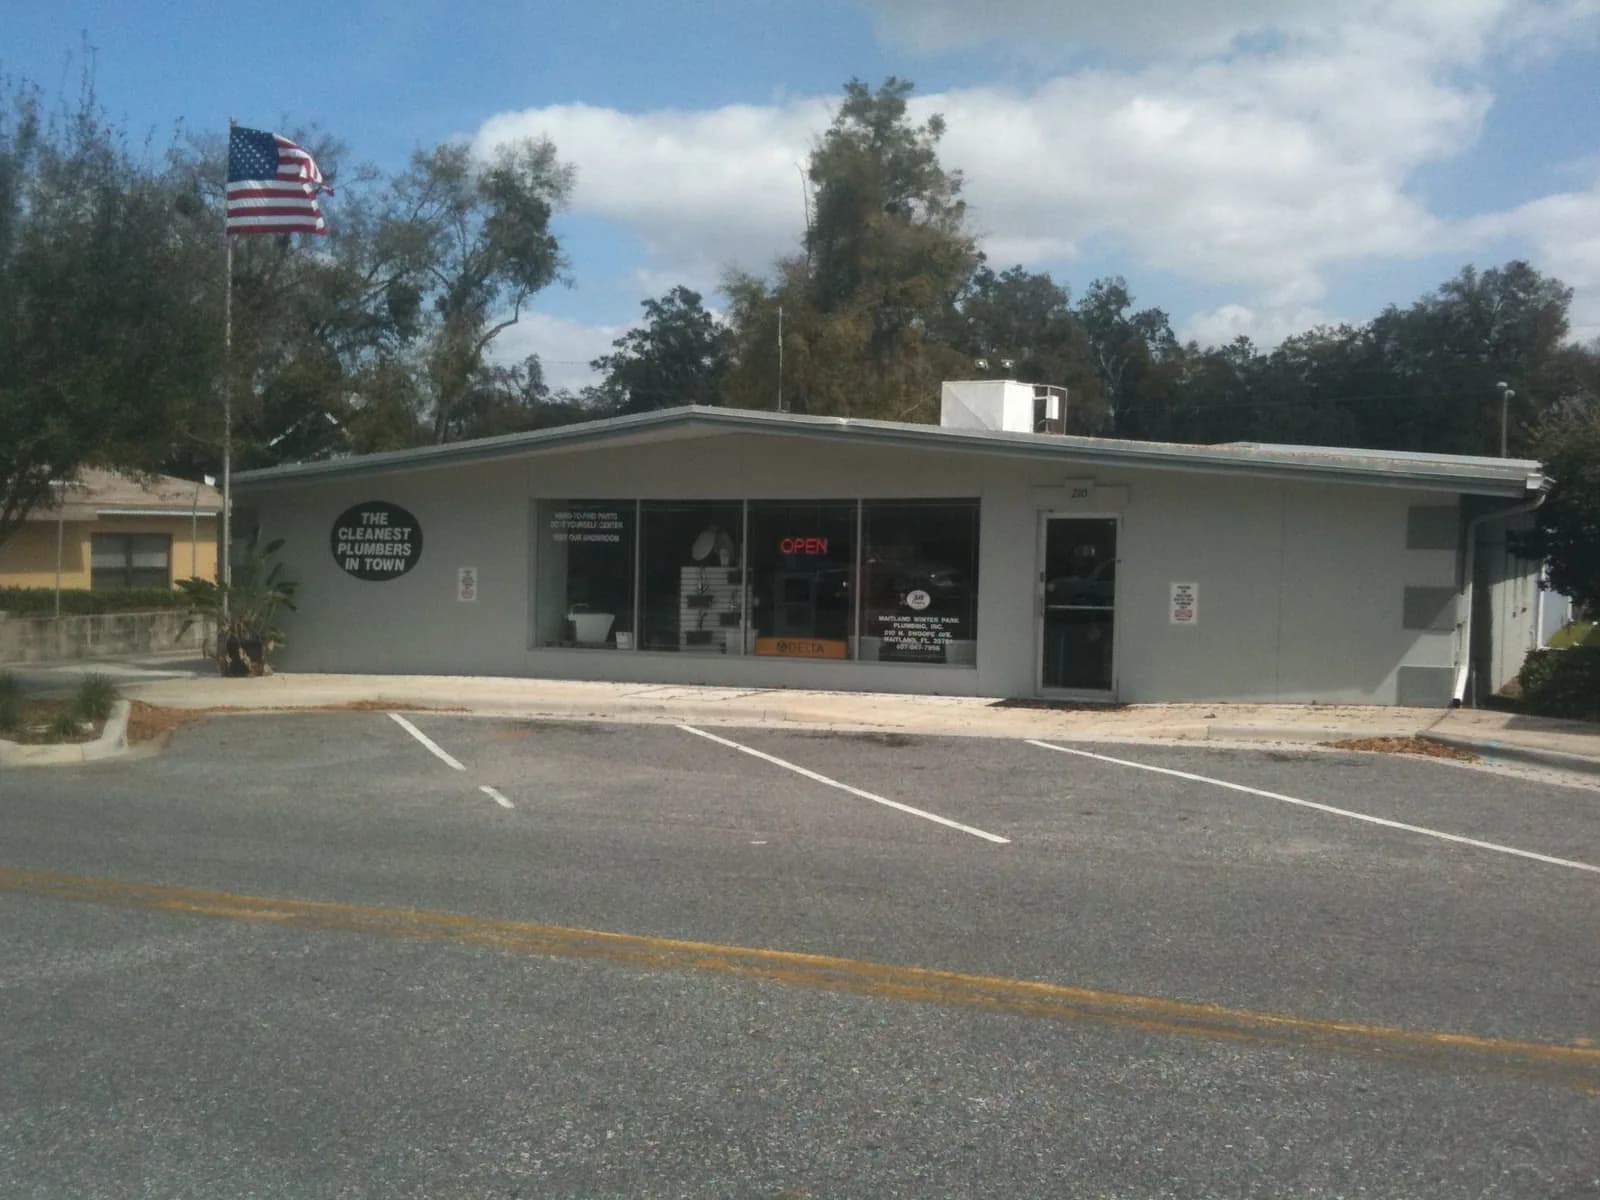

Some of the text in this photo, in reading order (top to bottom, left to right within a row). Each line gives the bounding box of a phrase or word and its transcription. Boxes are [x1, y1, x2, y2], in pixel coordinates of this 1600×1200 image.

[361, 512, 389, 525] THE
[338, 528, 412, 541] CLEANEST
[337, 543, 412, 557] PLUMBERS
[780, 537, 828, 555] OPEN
[345, 558, 406, 571] IN TOWN
[788, 641, 825, 654] DELTA
